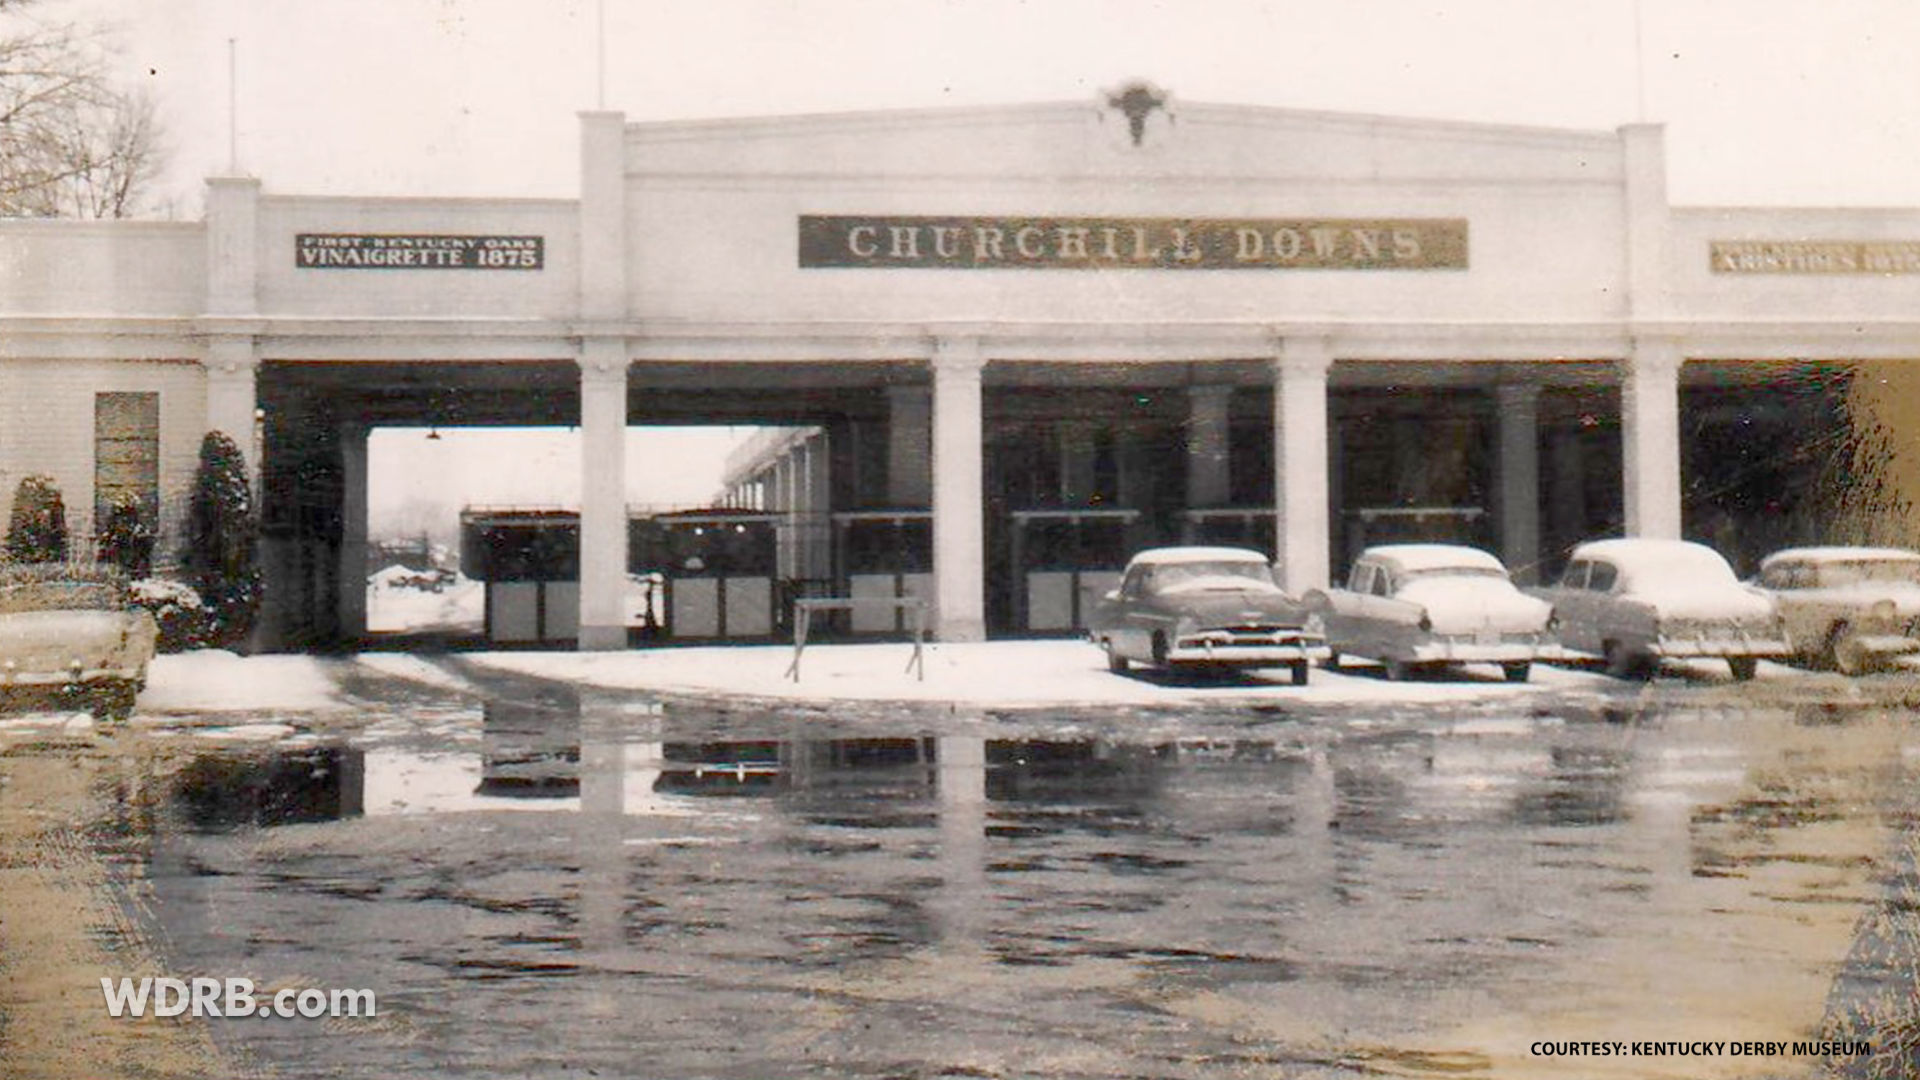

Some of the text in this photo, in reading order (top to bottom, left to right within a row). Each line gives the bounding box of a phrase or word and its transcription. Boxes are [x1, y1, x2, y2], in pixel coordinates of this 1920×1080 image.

[304, 238, 536, 248] FIRST KENTUCKY OAKS
[850, 226, 1422, 259] CHURCHILL DOWNS
[302, 249, 536, 266] VINAIGRETTE 1875
